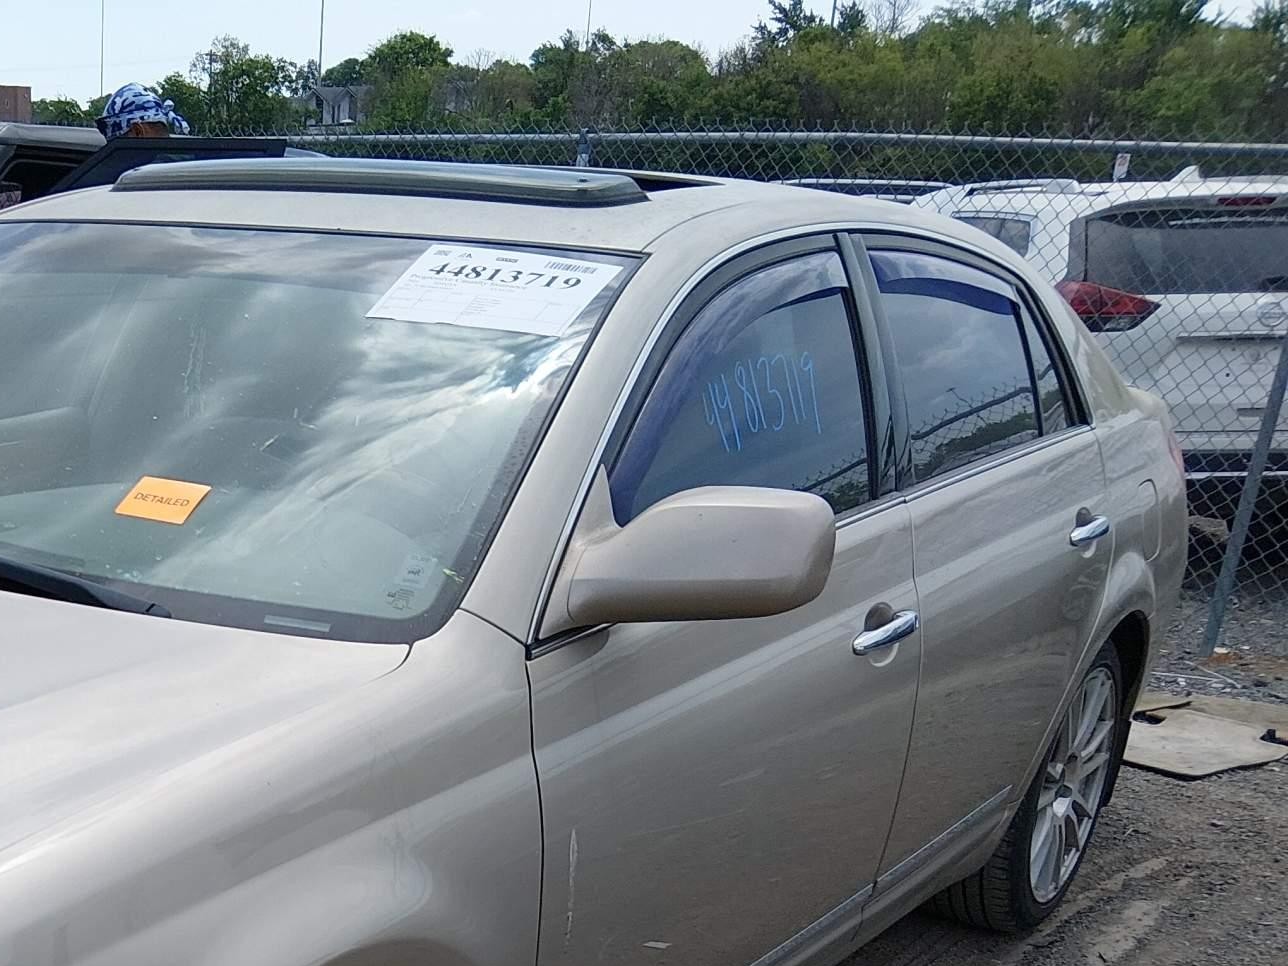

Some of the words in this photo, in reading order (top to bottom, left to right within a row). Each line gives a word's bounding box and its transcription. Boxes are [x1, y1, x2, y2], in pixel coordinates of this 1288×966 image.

[428, 262, 582, 289] 44813719
[702, 351, 822, 453] 44813719
[134, 492, 191, 507] DETAILED
